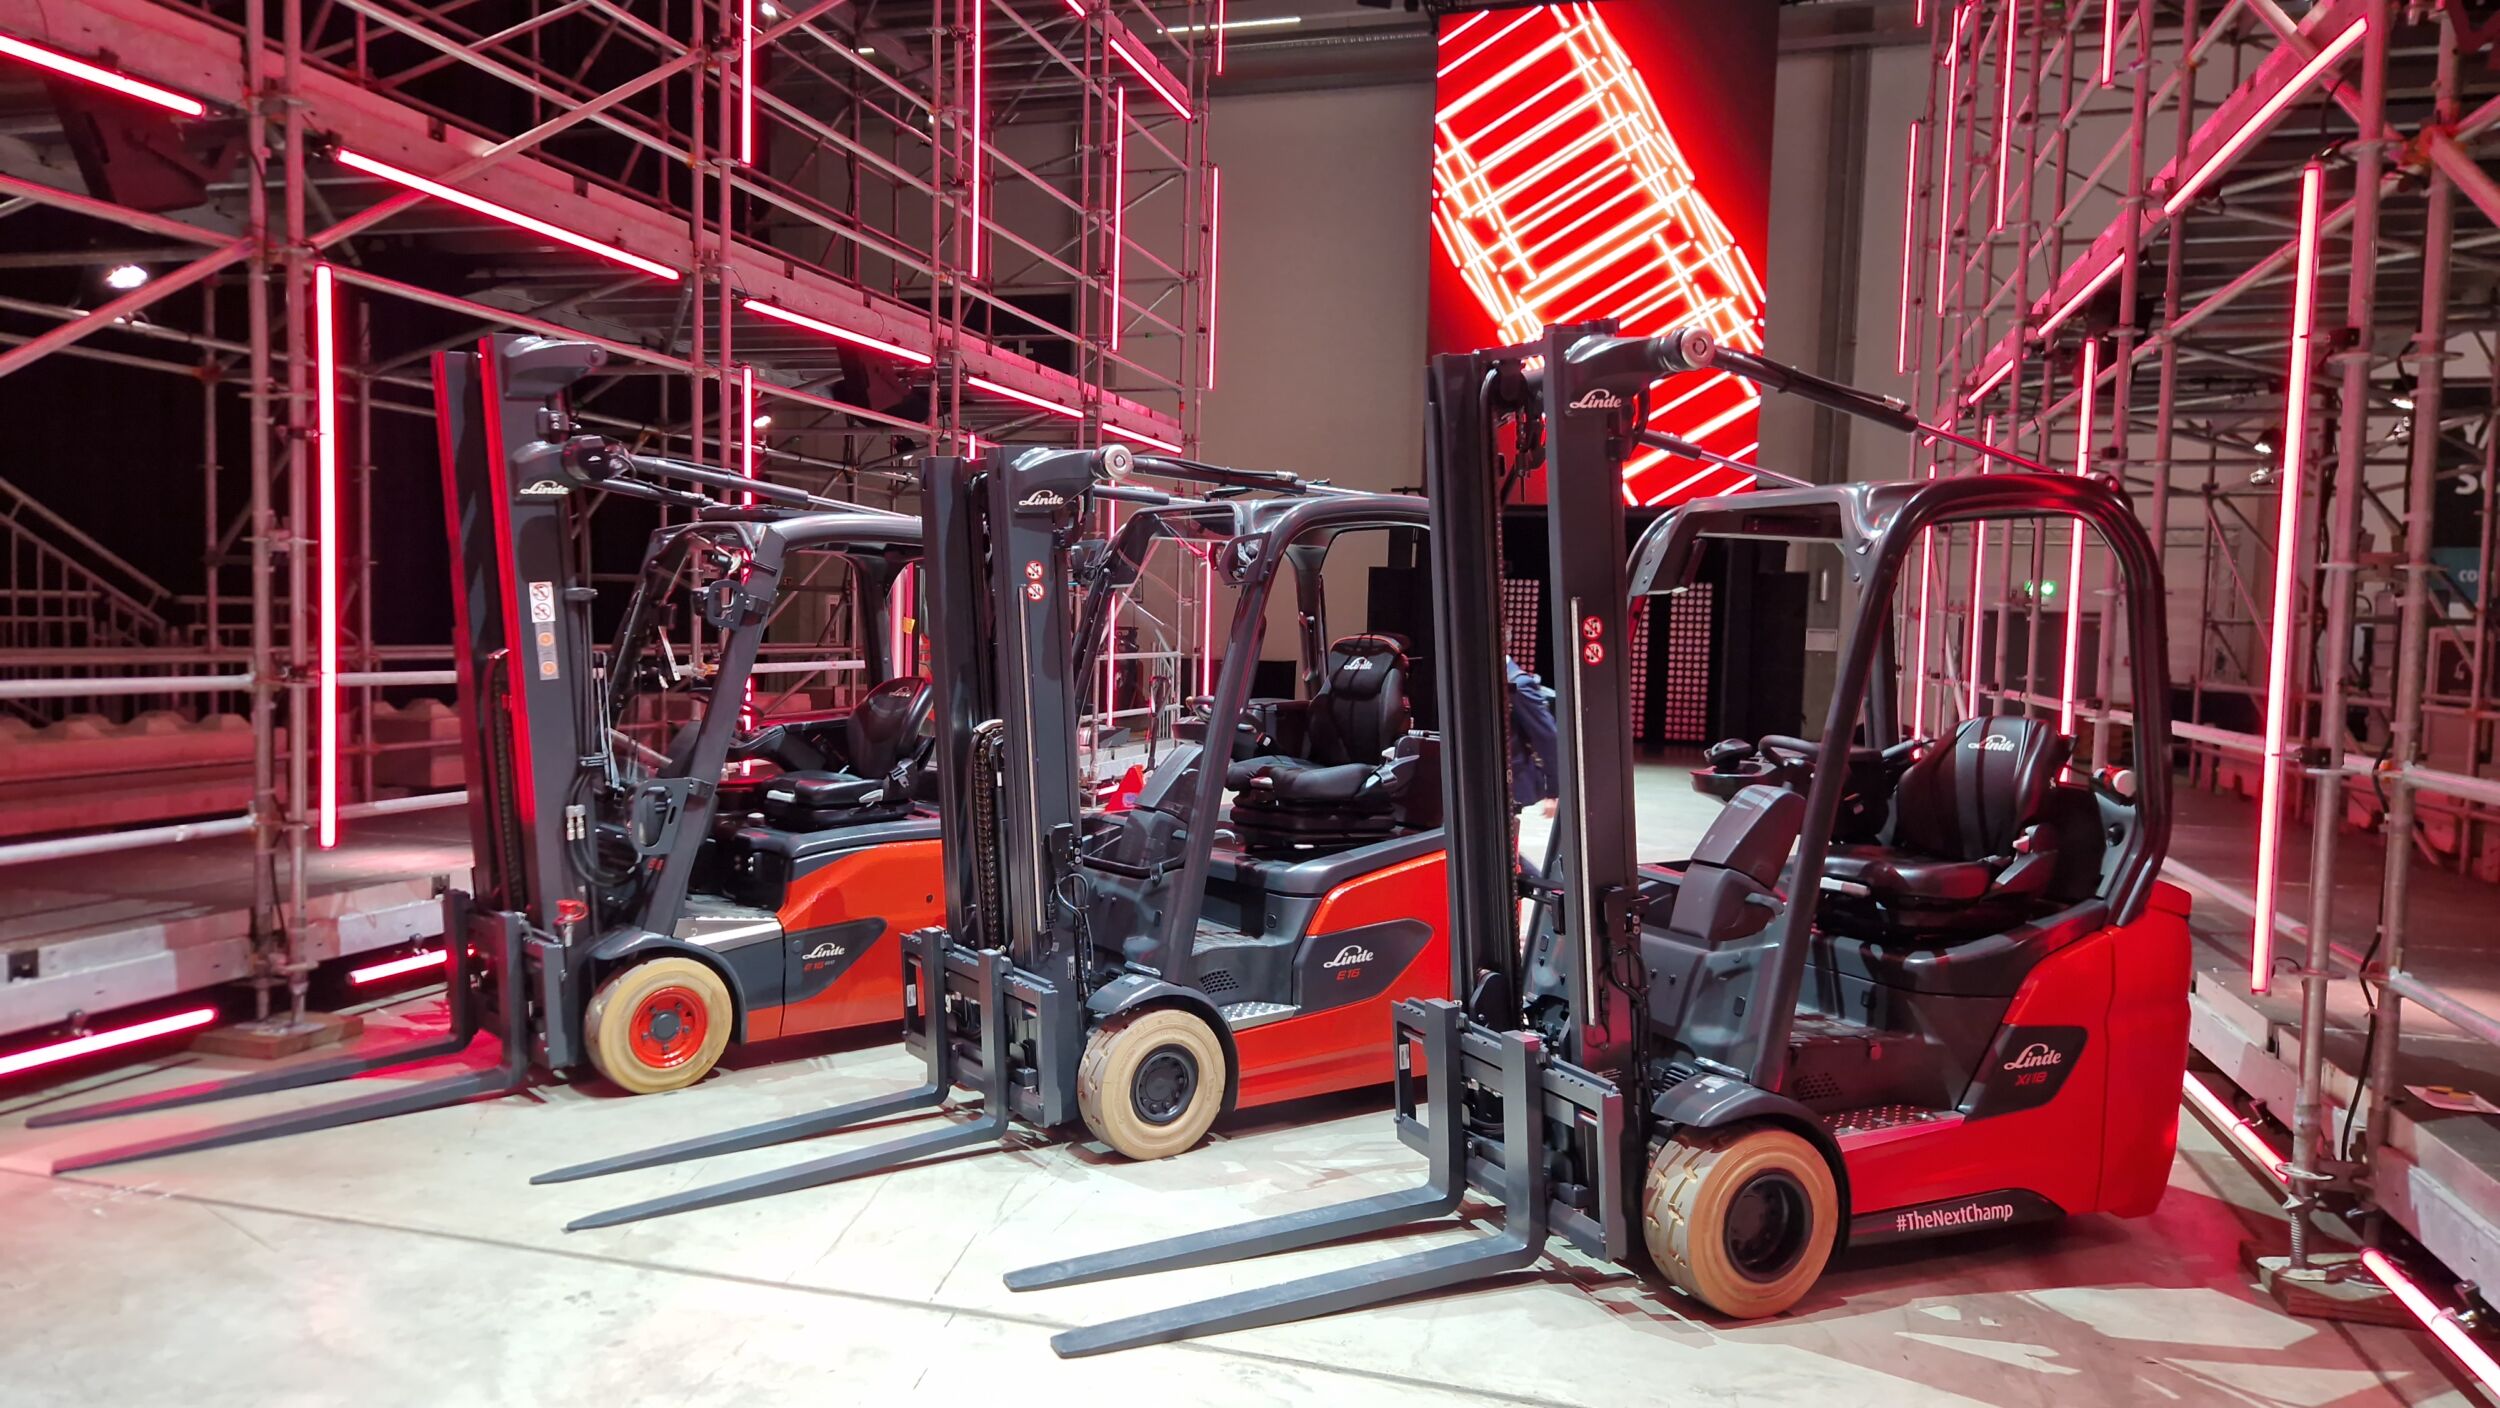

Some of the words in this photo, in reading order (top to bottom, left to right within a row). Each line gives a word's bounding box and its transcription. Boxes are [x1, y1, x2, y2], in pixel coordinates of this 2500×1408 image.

[1569, 388, 1622, 409] Linde
[519, 479, 569, 495] Linde
[1018, 489, 1064, 506] Linde
[1967, 734, 2015, 752] Linde
[802, 942, 845, 960] Linde
[1323, 944, 1374, 969] Linde
[2003, 1043, 2062, 1071] Linde
[1896, 1203, 2014, 1232] #TheNextChamp
